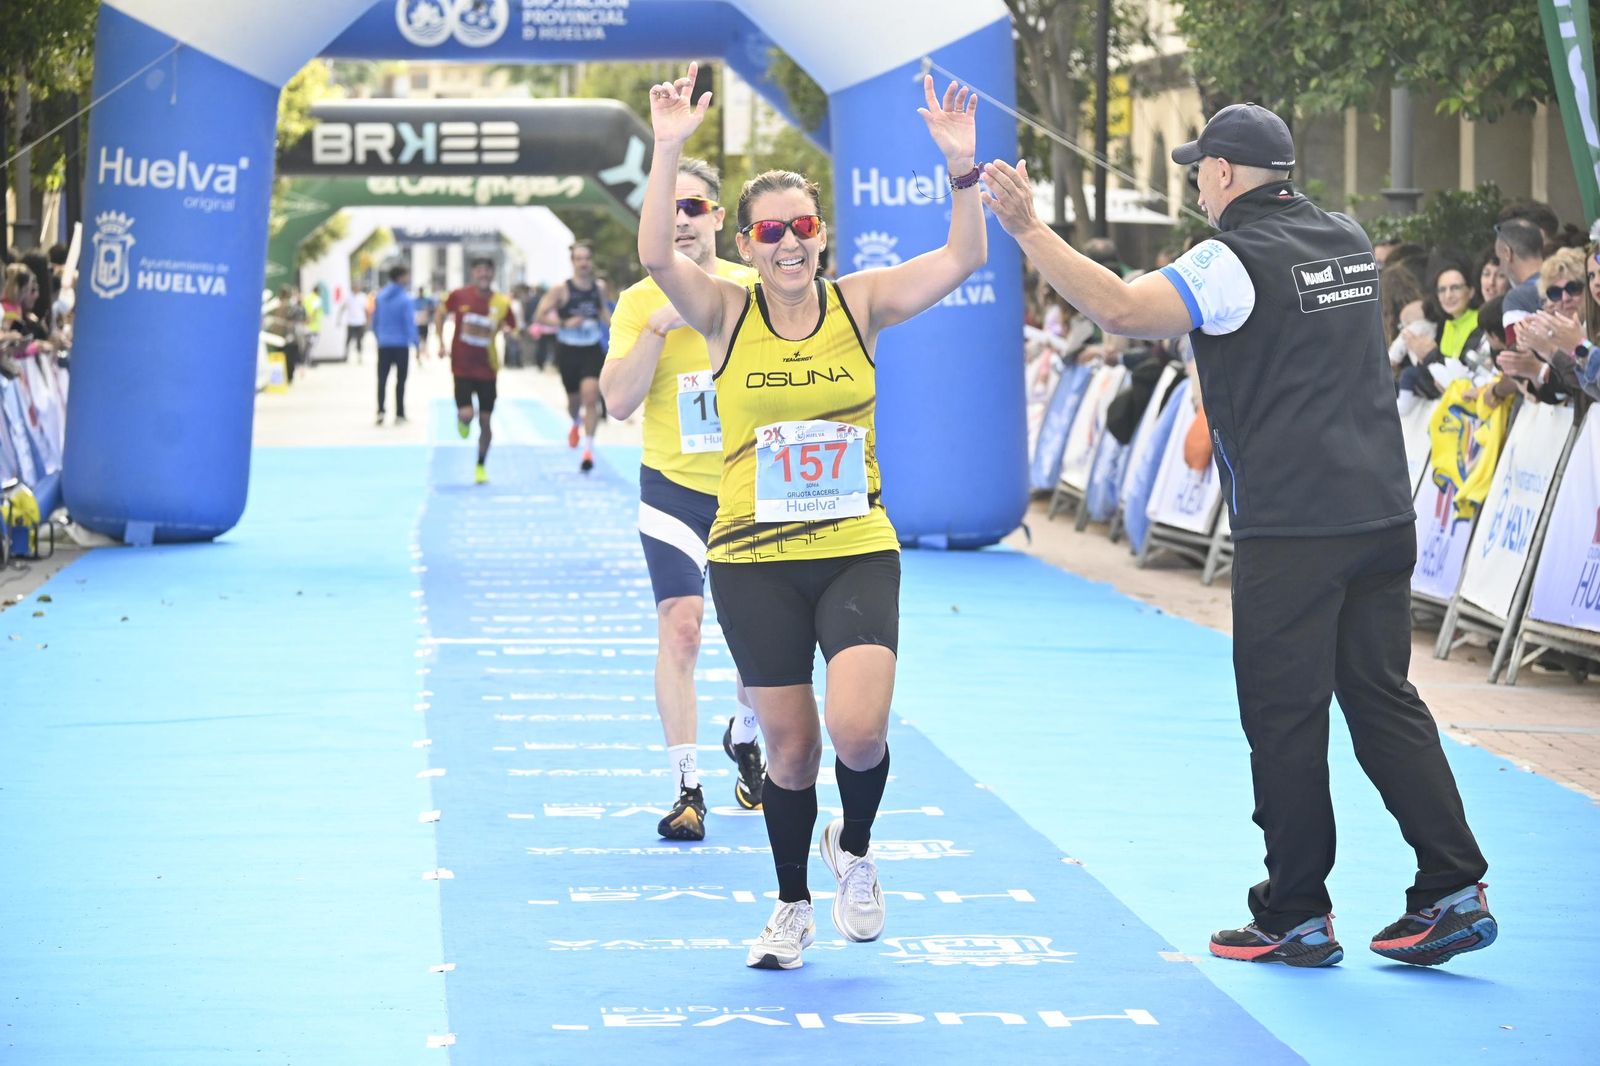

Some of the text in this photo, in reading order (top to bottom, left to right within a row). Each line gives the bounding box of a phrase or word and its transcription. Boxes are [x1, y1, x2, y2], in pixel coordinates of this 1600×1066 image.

[98, 146, 237, 194] Huelva
[183, 197, 236, 213] original
[136, 270, 228, 296] HUELVA
[1300, 265, 1335, 287] MARKER
[1316, 285, 1373, 305] DALBELLO
[745, 366, 854, 389] OSUNA
[774, 442, 849, 482] 157
[811, 488, 840, 497] CACERES
[786, 498, 837, 513] Huelva
[600, 1005, 786, 1015] original
[600, 1009, 1160, 1028] Huelva
